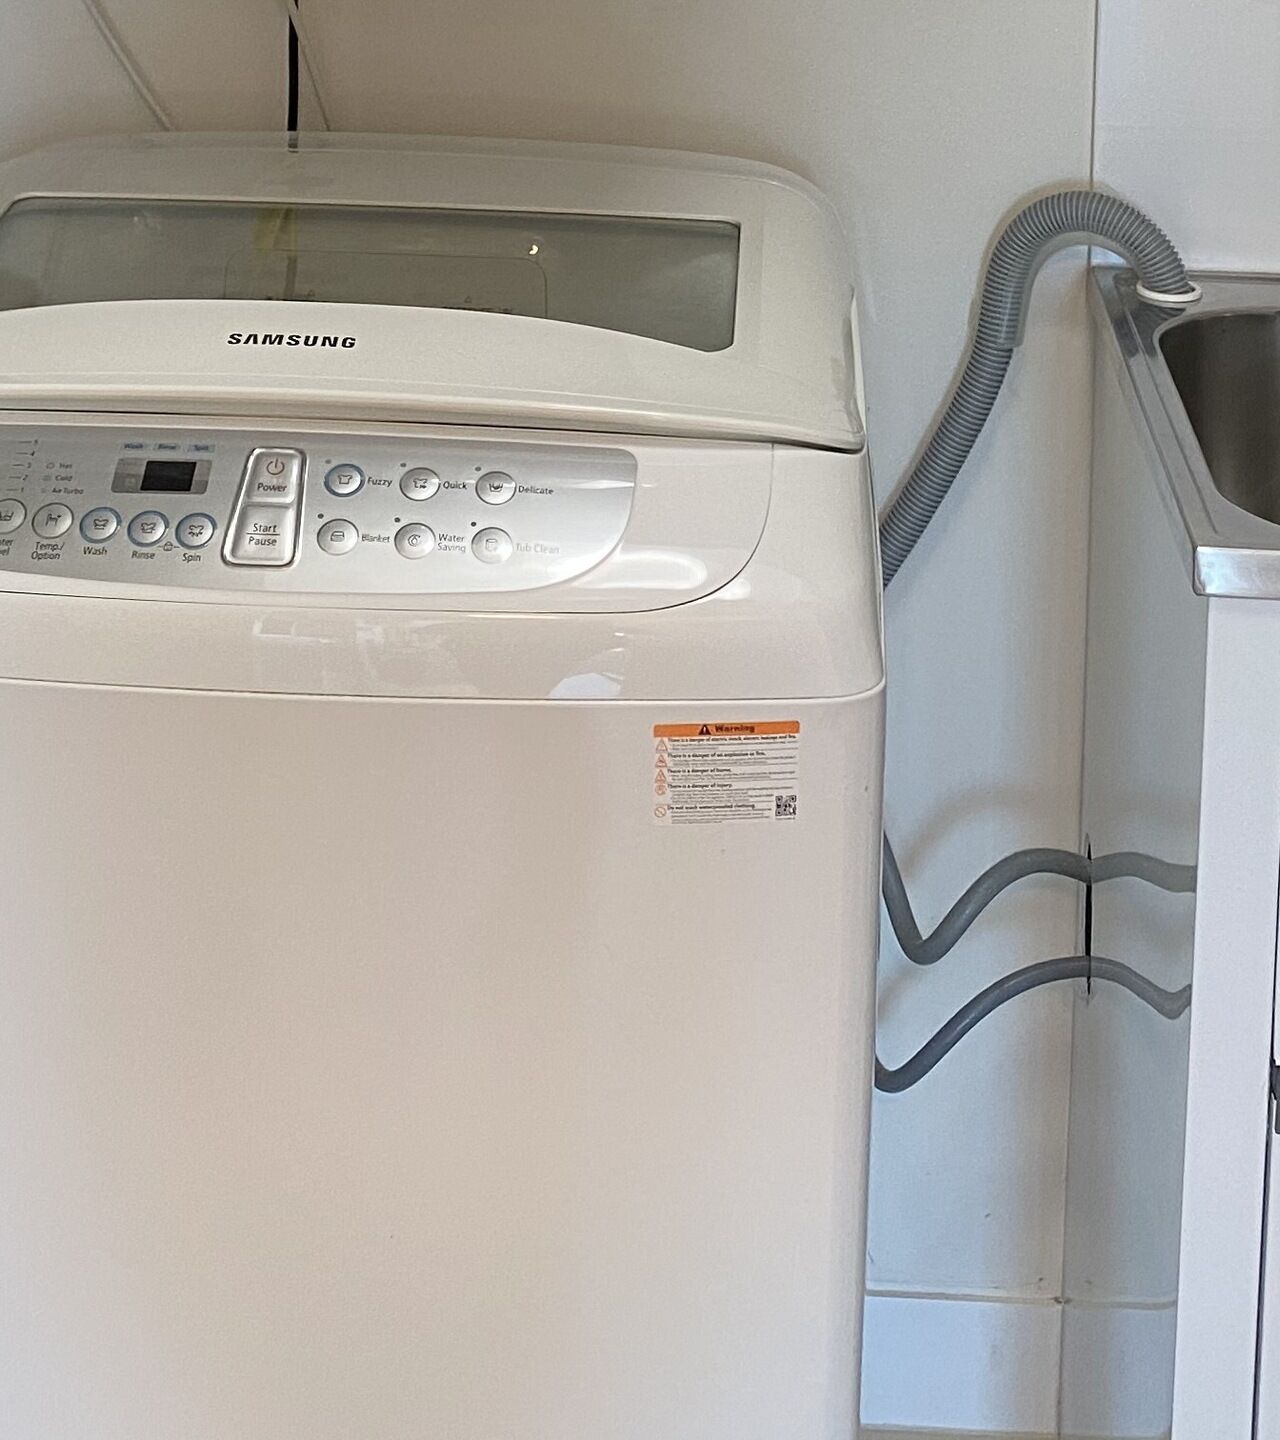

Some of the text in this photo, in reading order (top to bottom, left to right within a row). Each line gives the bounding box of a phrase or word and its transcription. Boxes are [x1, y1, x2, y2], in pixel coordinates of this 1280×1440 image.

[227, 333, 356, 348] SAMSUNG
[257, 483, 287, 492] Power
[367, 477, 393, 489] Fuzzy
[442, 481, 468, 491] Quick
[518, 485, 554, 495] Delicate
[253, 523, 277, 532] Start
[248, 537, 277, 546] Pause
[438, 533, 465, 543] Water
[83, 546, 108, 556] Wash
[437, 542, 466, 553] Saving
[31, 551, 61, 561] Option
[131, 550, 156, 560] Rinse
[182, 553, 202, 563] Spin
[715, 724, 755, 733] Warning
